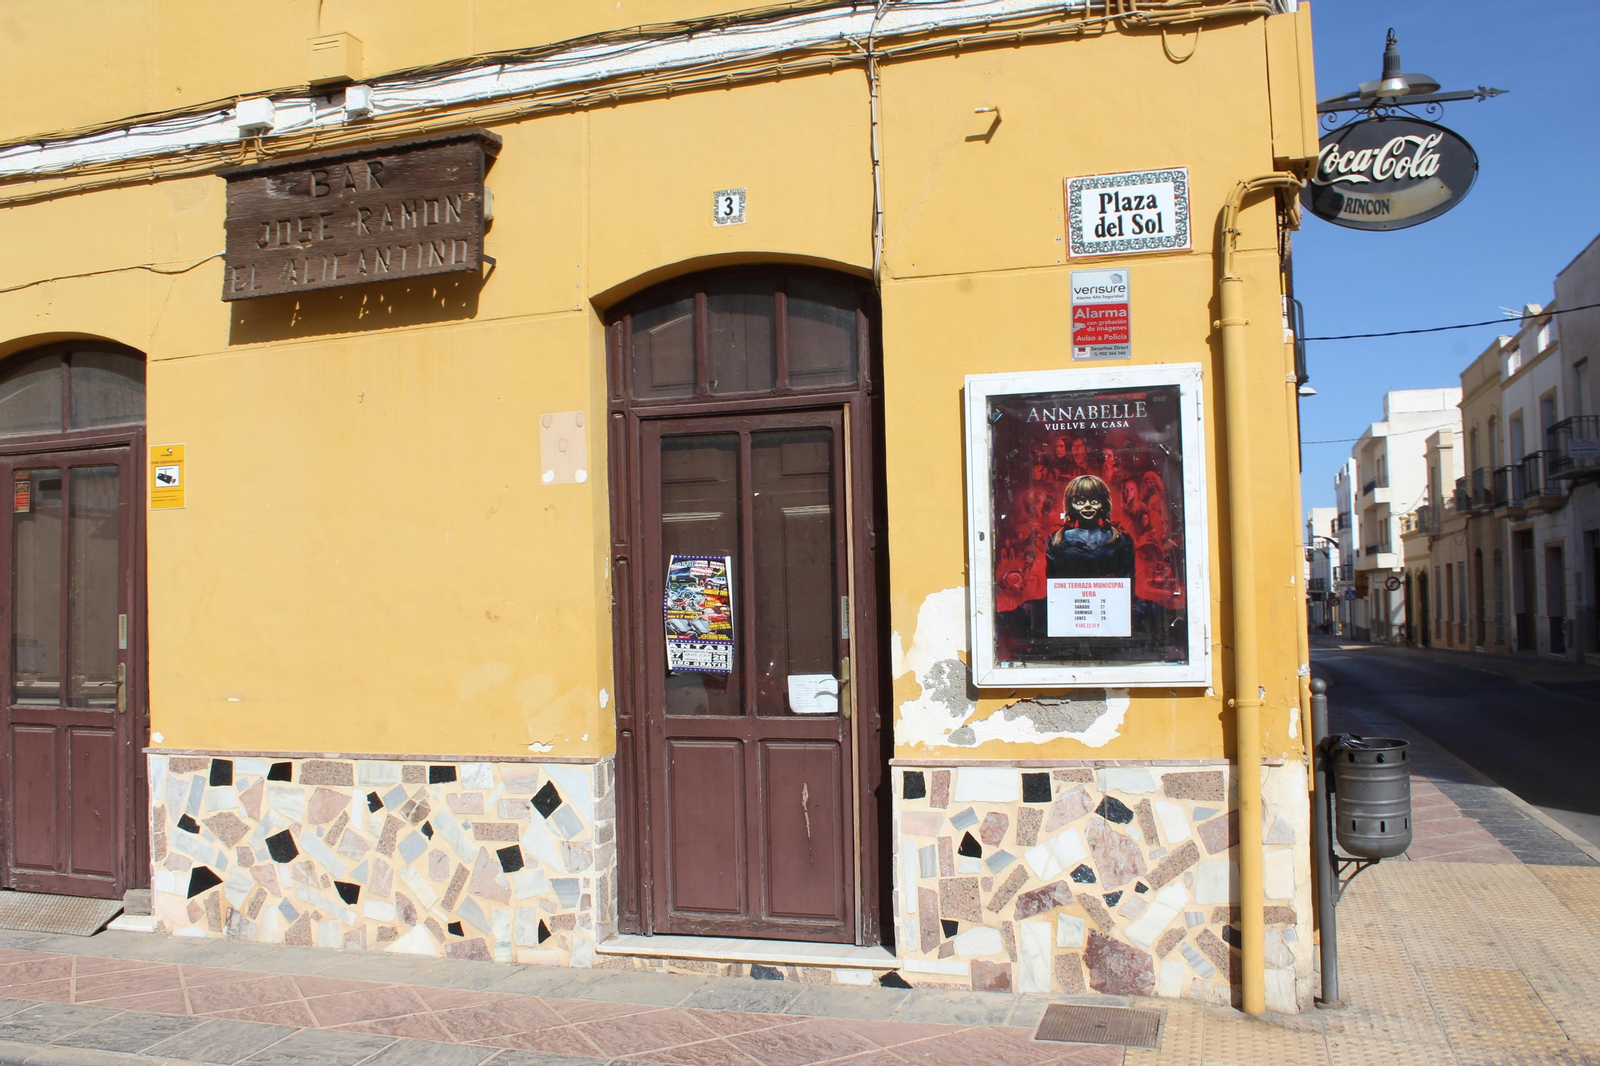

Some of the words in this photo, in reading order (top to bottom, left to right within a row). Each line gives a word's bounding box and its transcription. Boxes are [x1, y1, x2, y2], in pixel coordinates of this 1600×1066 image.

[1312, 132, 1443, 186] Coca-Cola
[310, 160, 385, 198] BAR
[724, 196, 734, 217] 3
[1098, 191, 1158, 214] Plaza
[1343, 197, 1391, 215] RINCON
[256, 211, 335, 250] JOSE
[357, 192, 462, 236] RAMON
[1094, 216, 1124, 238] del
[1131, 212, 1164, 235] Sol
[231, 264, 262, 293] EL
[280, 238, 469, 286] ALICANTINO
[1074, 284, 1126, 295] verisure
[1074, 307, 1127, 320] Alarma
[1097, 324, 1127, 332] imágenes
[1026, 401, 1148, 423] ANNABELLE
[1044, 421, 1086, 431] VUELVE
[1101, 420, 1130, 428] CASA
